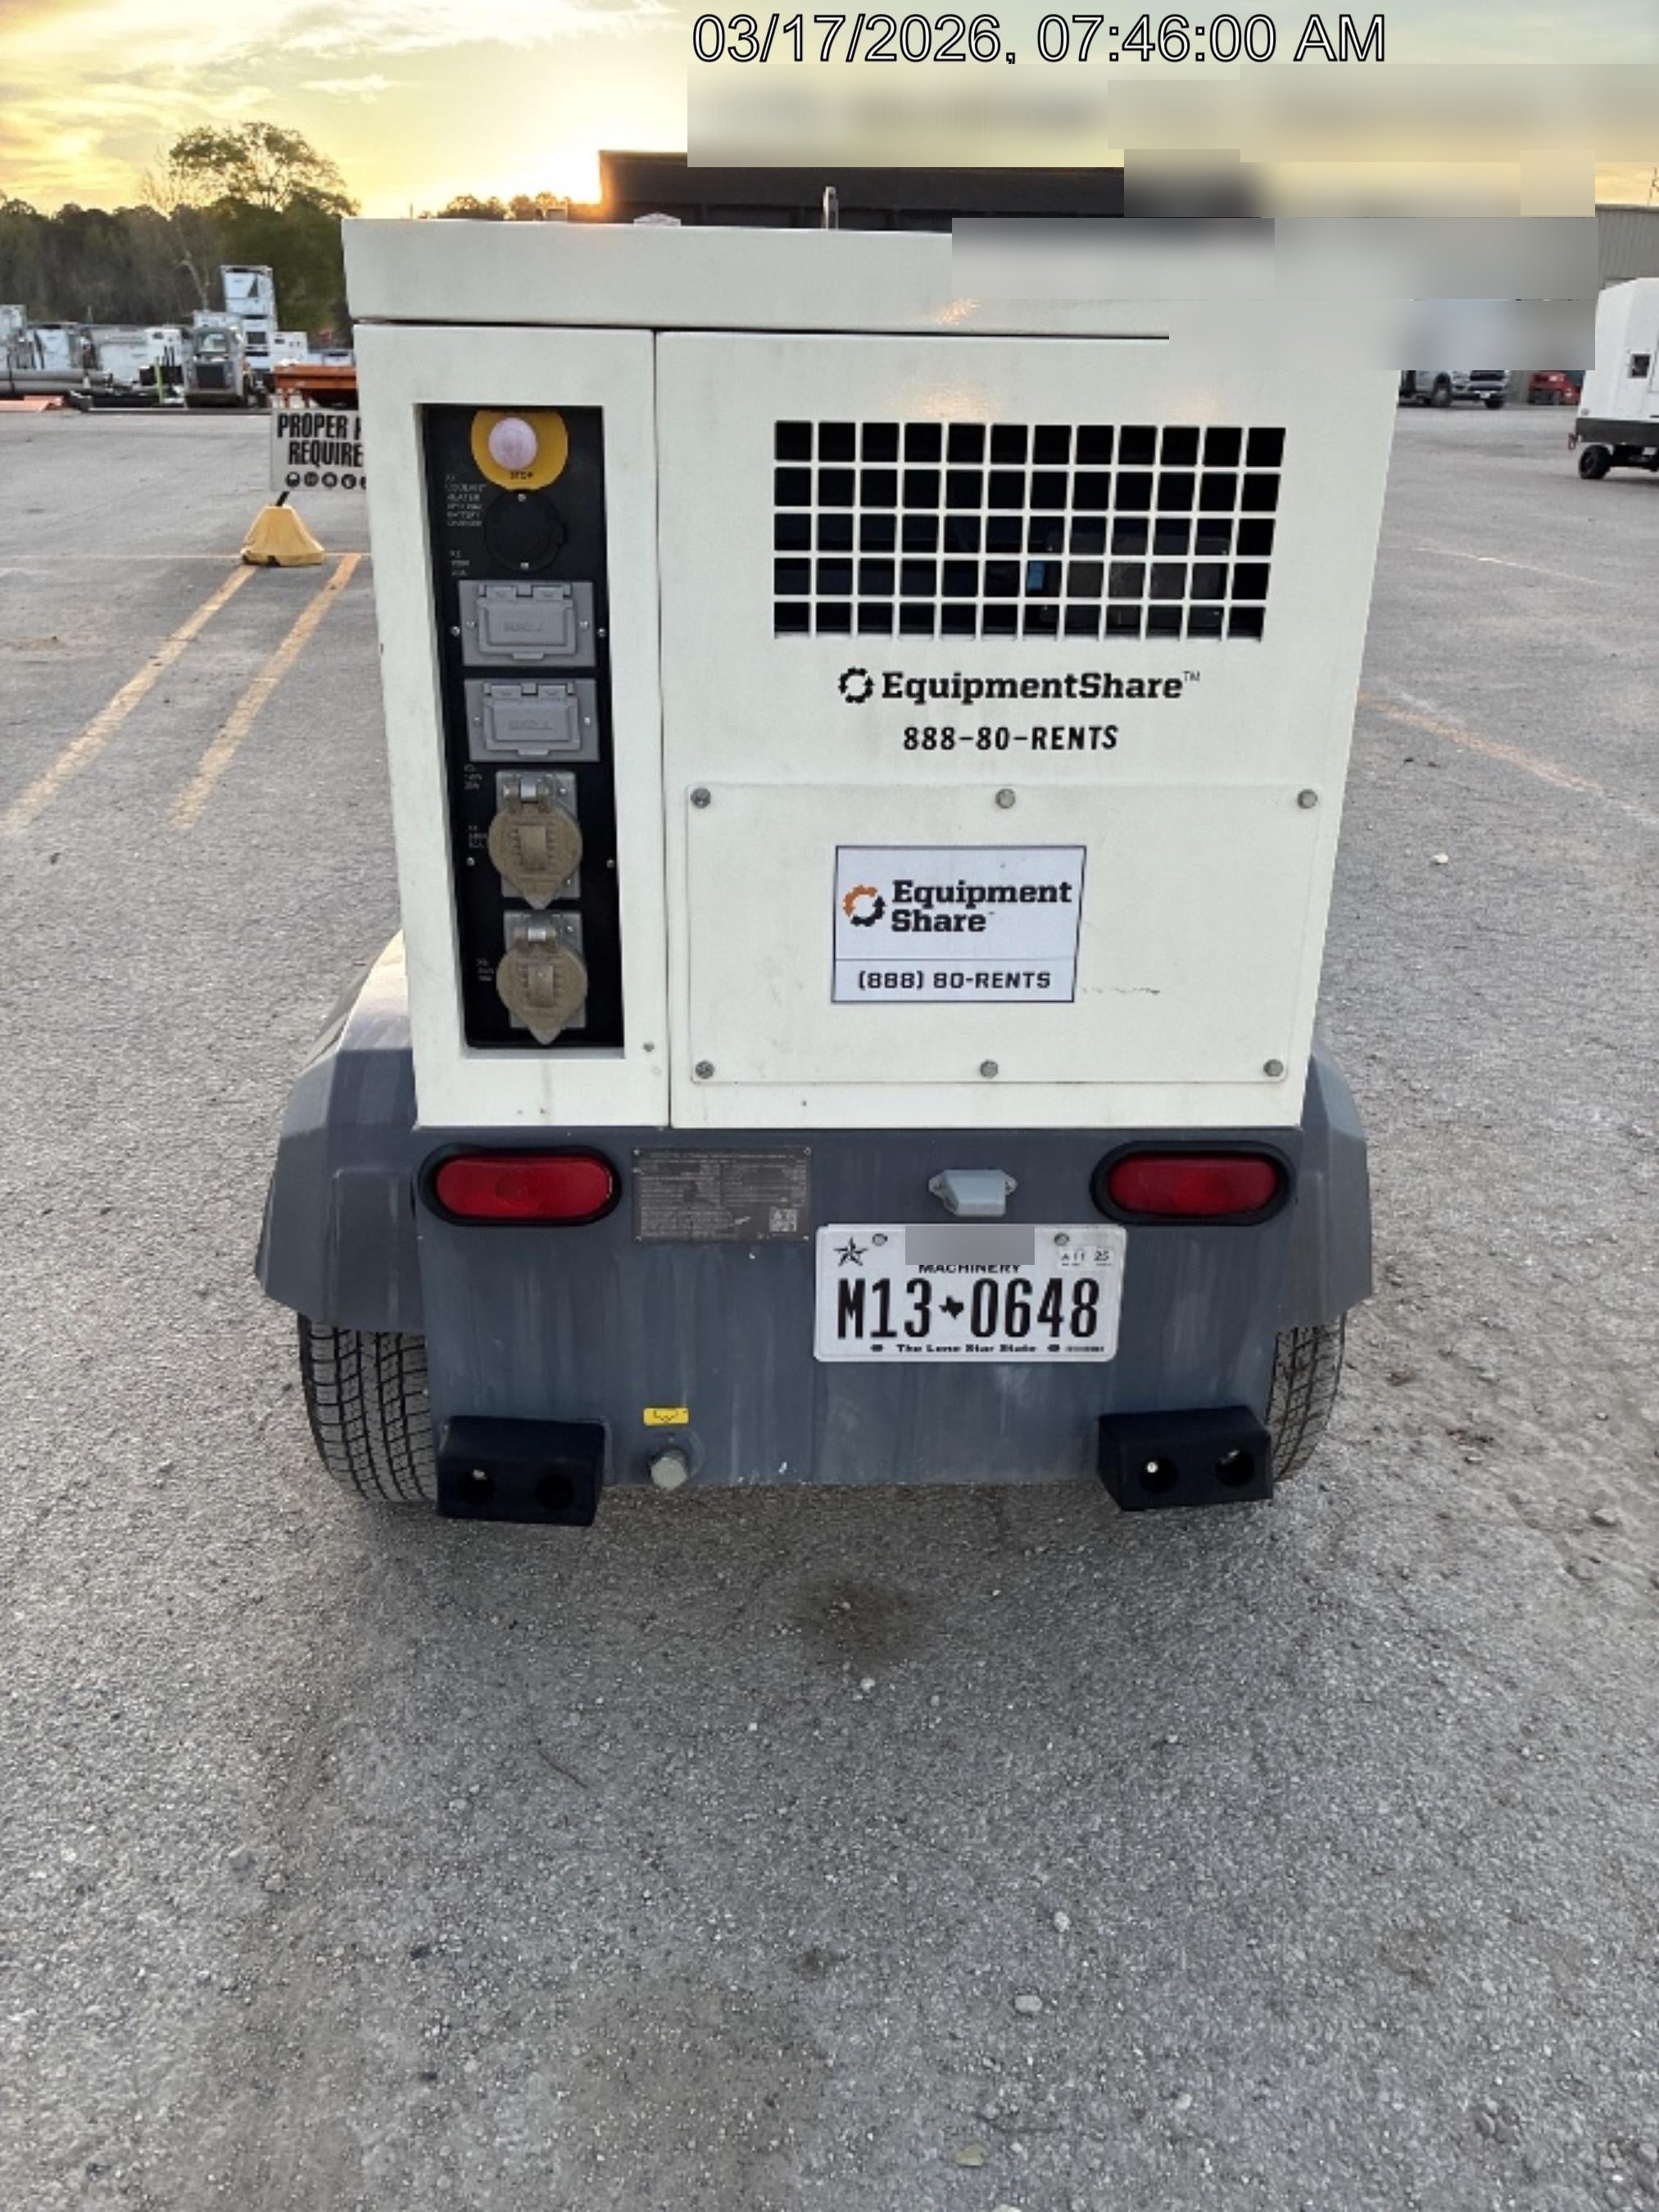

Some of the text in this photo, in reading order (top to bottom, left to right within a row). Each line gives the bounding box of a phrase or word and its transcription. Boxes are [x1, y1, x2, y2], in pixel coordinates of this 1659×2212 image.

[277, 412, 348, 439] PROPER
[903, 725, 1119, 751] 888-80-RENTS
[891, 879, 1072, 909] Equipment
[891, 909, 987, 932] Share
[858, 971, 1051, 990] (888) 80-RENTS
[918, 1264, 1021, 1274] MACHINERY
[837, 1277, 1099, 1339] M13 0648
[896, 1344, 1036, 1353] The Lone Star State
